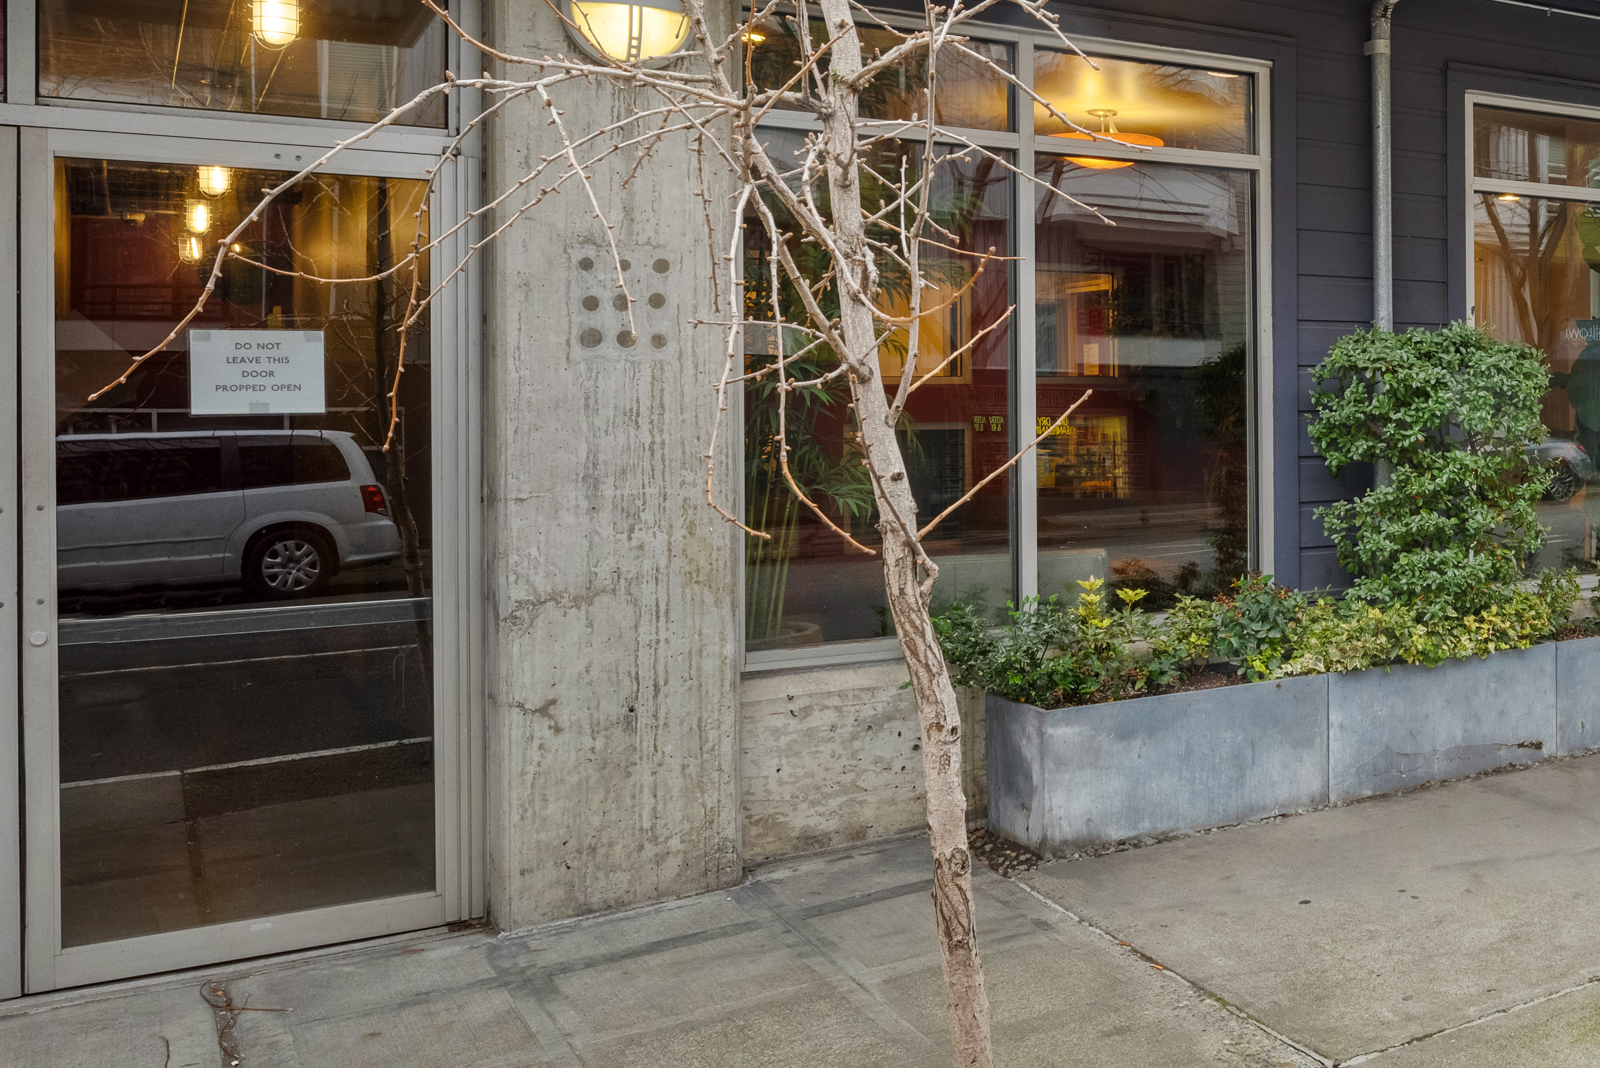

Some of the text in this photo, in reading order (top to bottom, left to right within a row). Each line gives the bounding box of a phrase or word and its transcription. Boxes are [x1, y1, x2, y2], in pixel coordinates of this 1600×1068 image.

[234, 342, 281, 350] DO NOT
[226, 356, 290, 364] LEAVE THIS
[241, 370, 275, 378] DOOR
[215, 384, 267, 392] PROPPED
